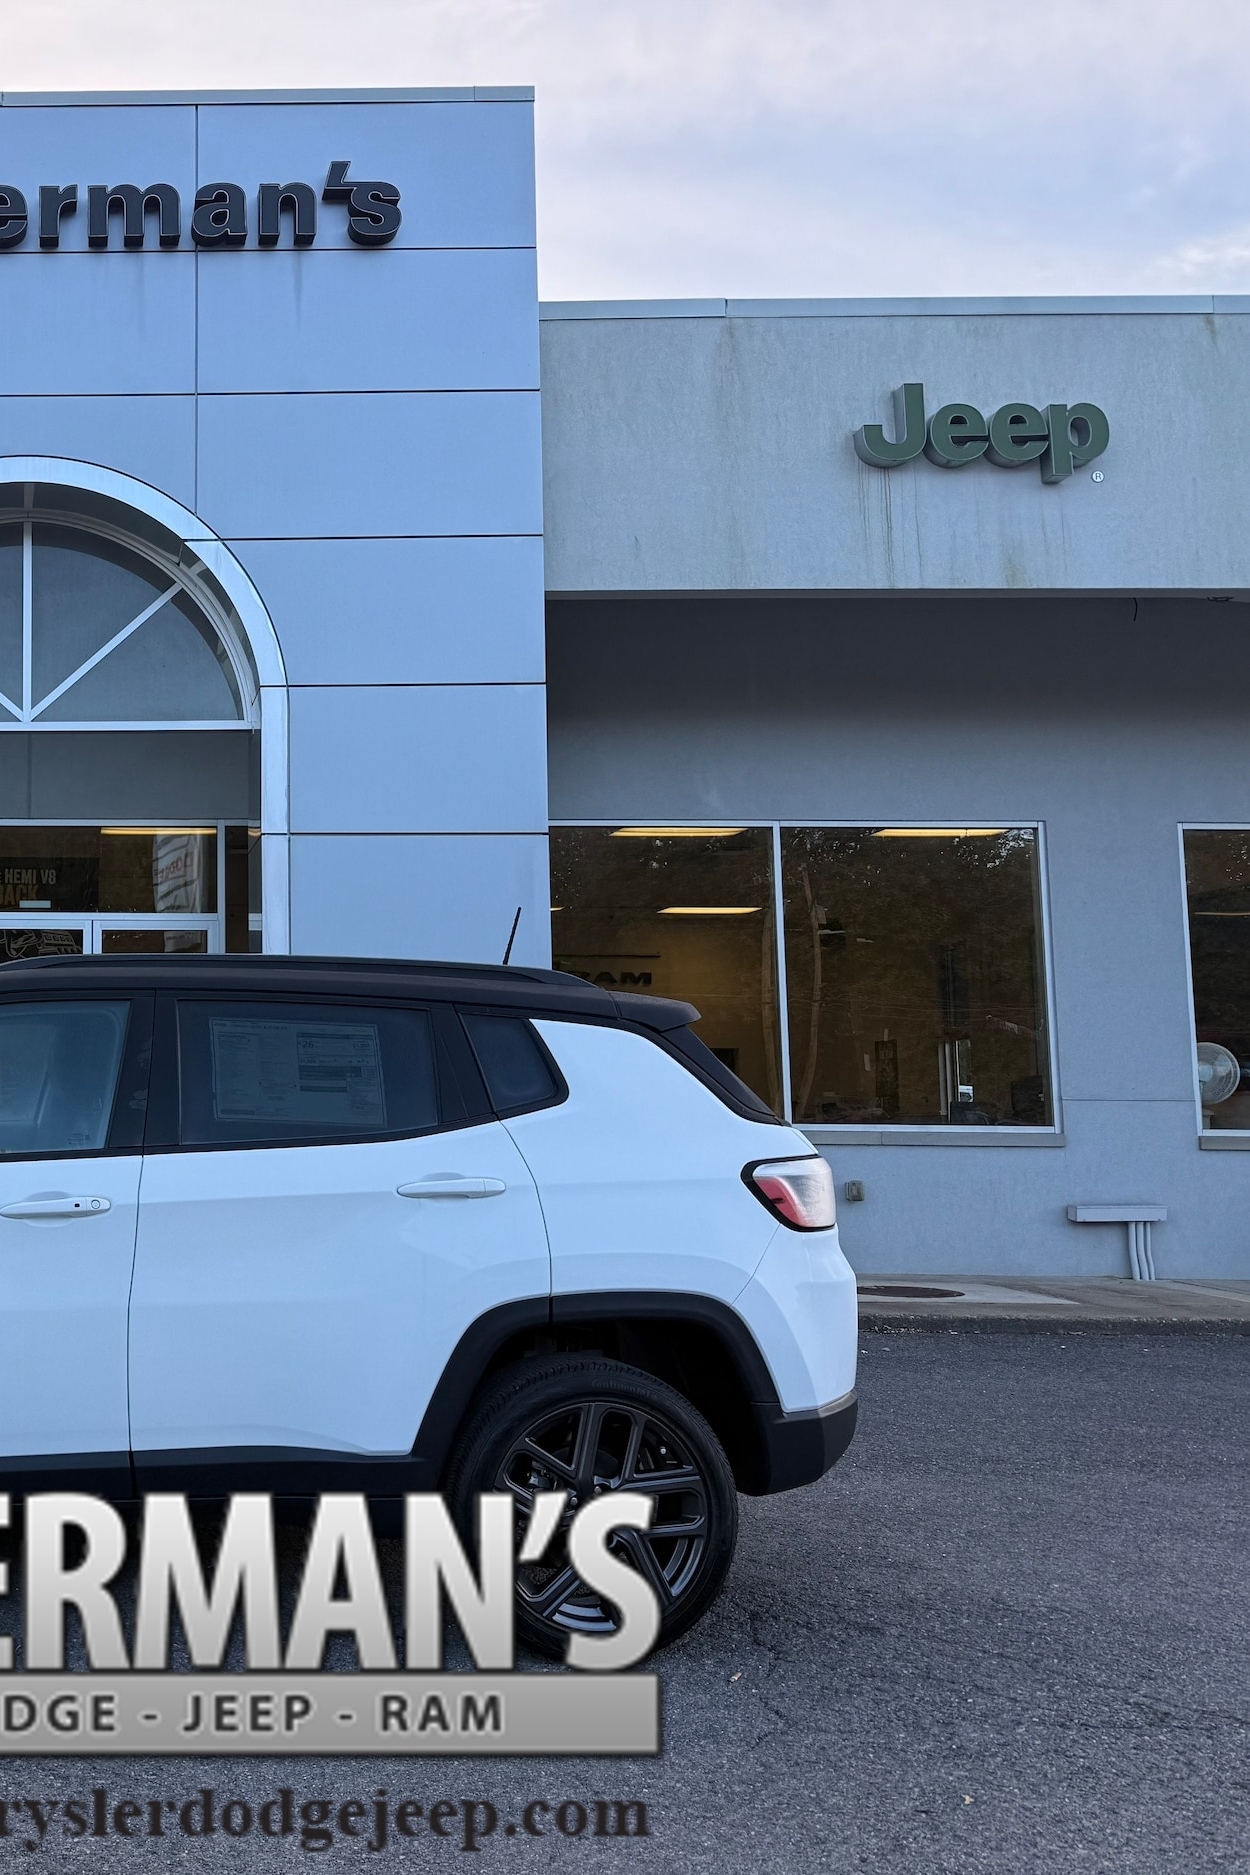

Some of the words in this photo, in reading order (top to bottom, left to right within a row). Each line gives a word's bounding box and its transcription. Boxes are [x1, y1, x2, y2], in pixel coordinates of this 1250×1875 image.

[853, 382, 1110, 484] Jeep
[4, 868, 37, 884] HEMI
[41, 869, 57, 885] V8
